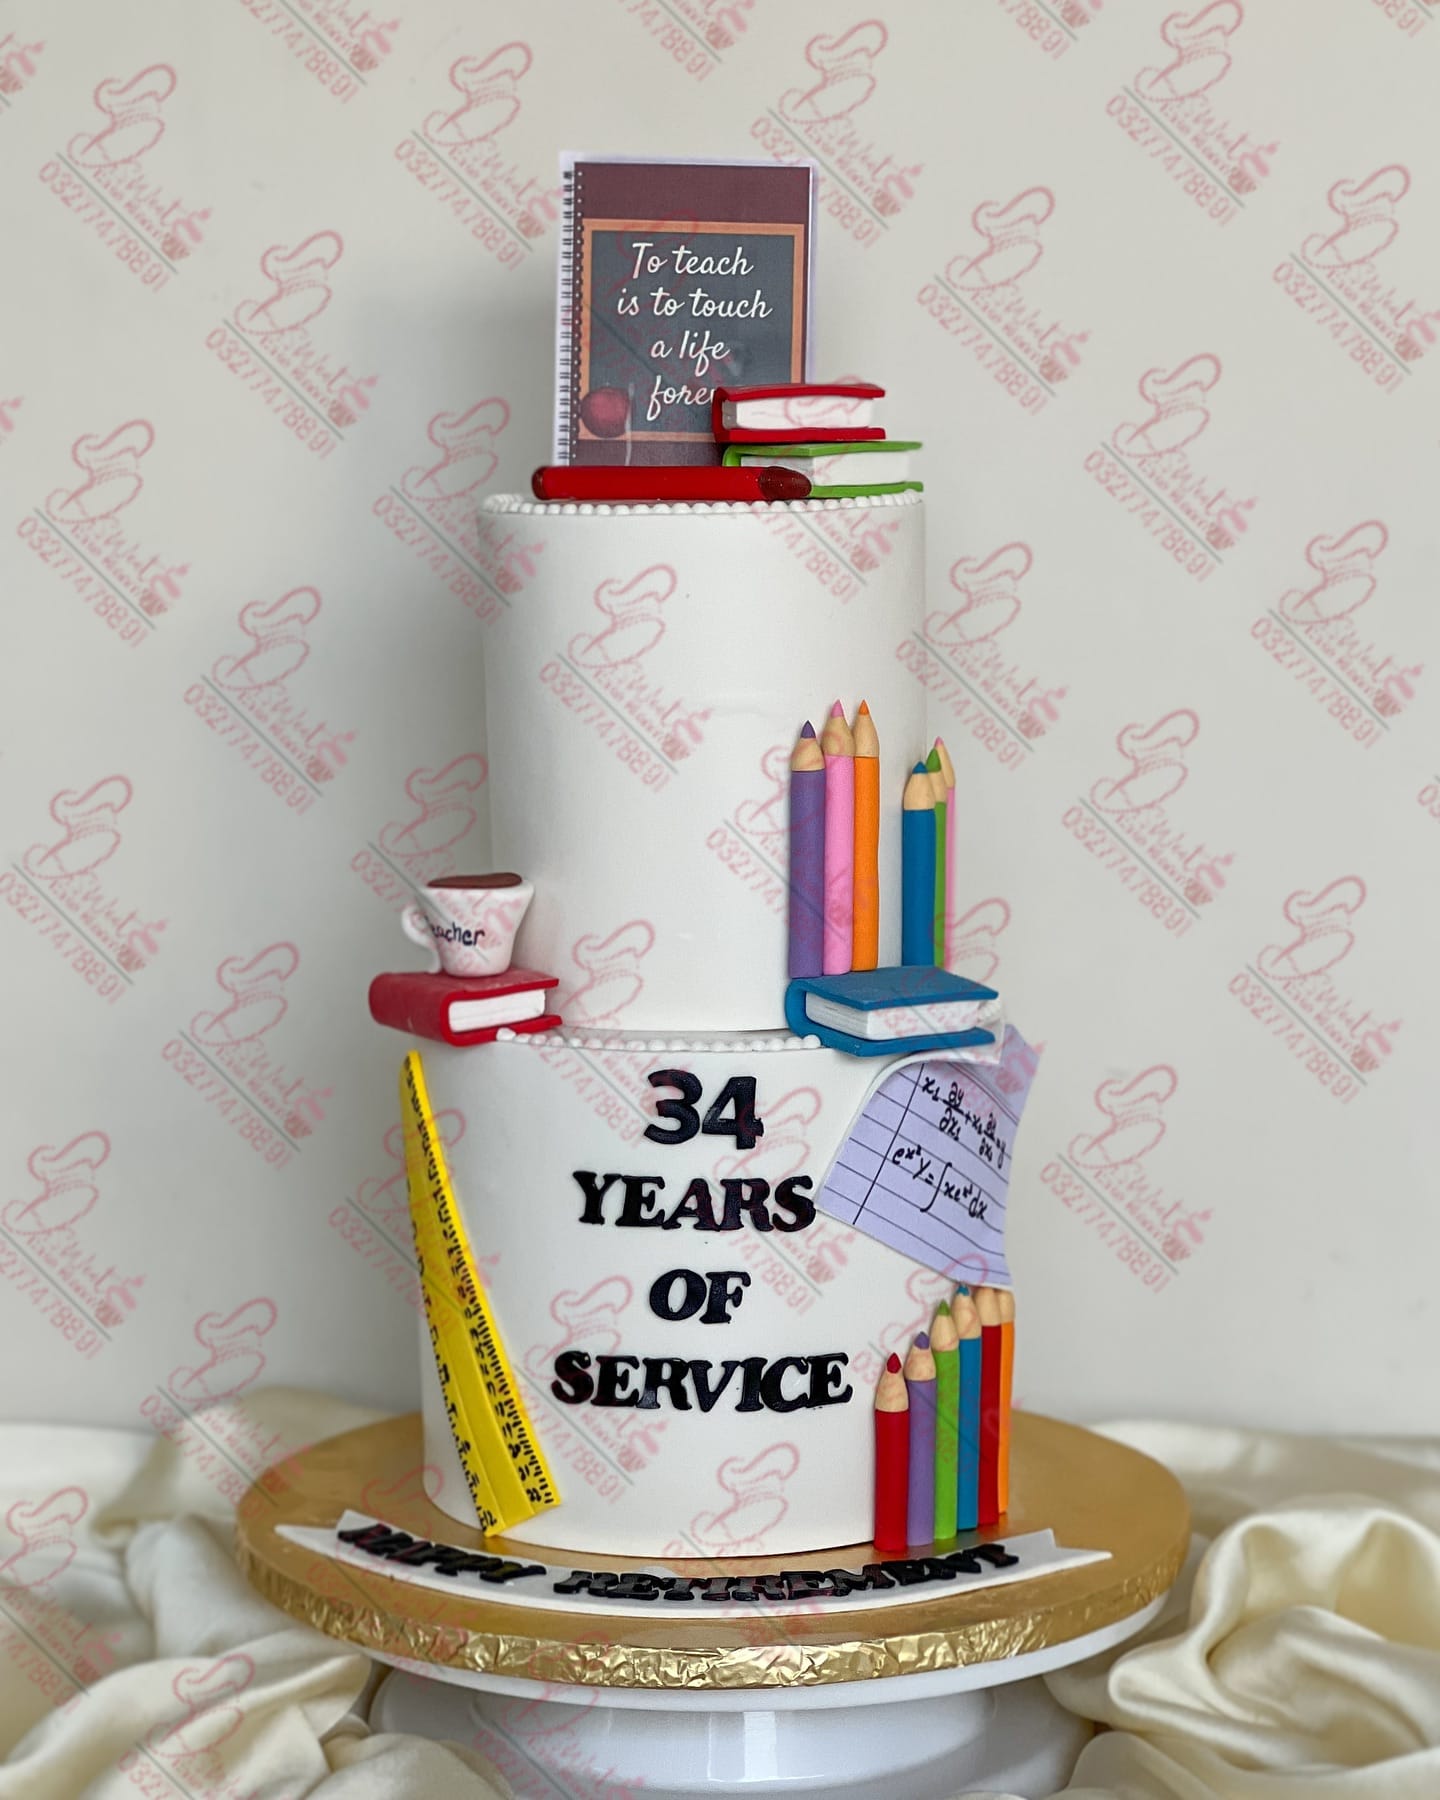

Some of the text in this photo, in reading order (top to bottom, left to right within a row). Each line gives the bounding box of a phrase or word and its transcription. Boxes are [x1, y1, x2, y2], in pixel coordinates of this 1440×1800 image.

[632, 242, 753, 279] To teach
[617, 288, 773, 319] is to touch
[651, 331, 730, 377] a life
[644, 1069, 764, 1150] 34
[572, 1171, 817, 1232] YEARS
[649, 1268, 751, 1324] OF
[551, 1351, 853, 1413] SERVICE
[553, 1543, 1019, 1601] RETIREMENT
